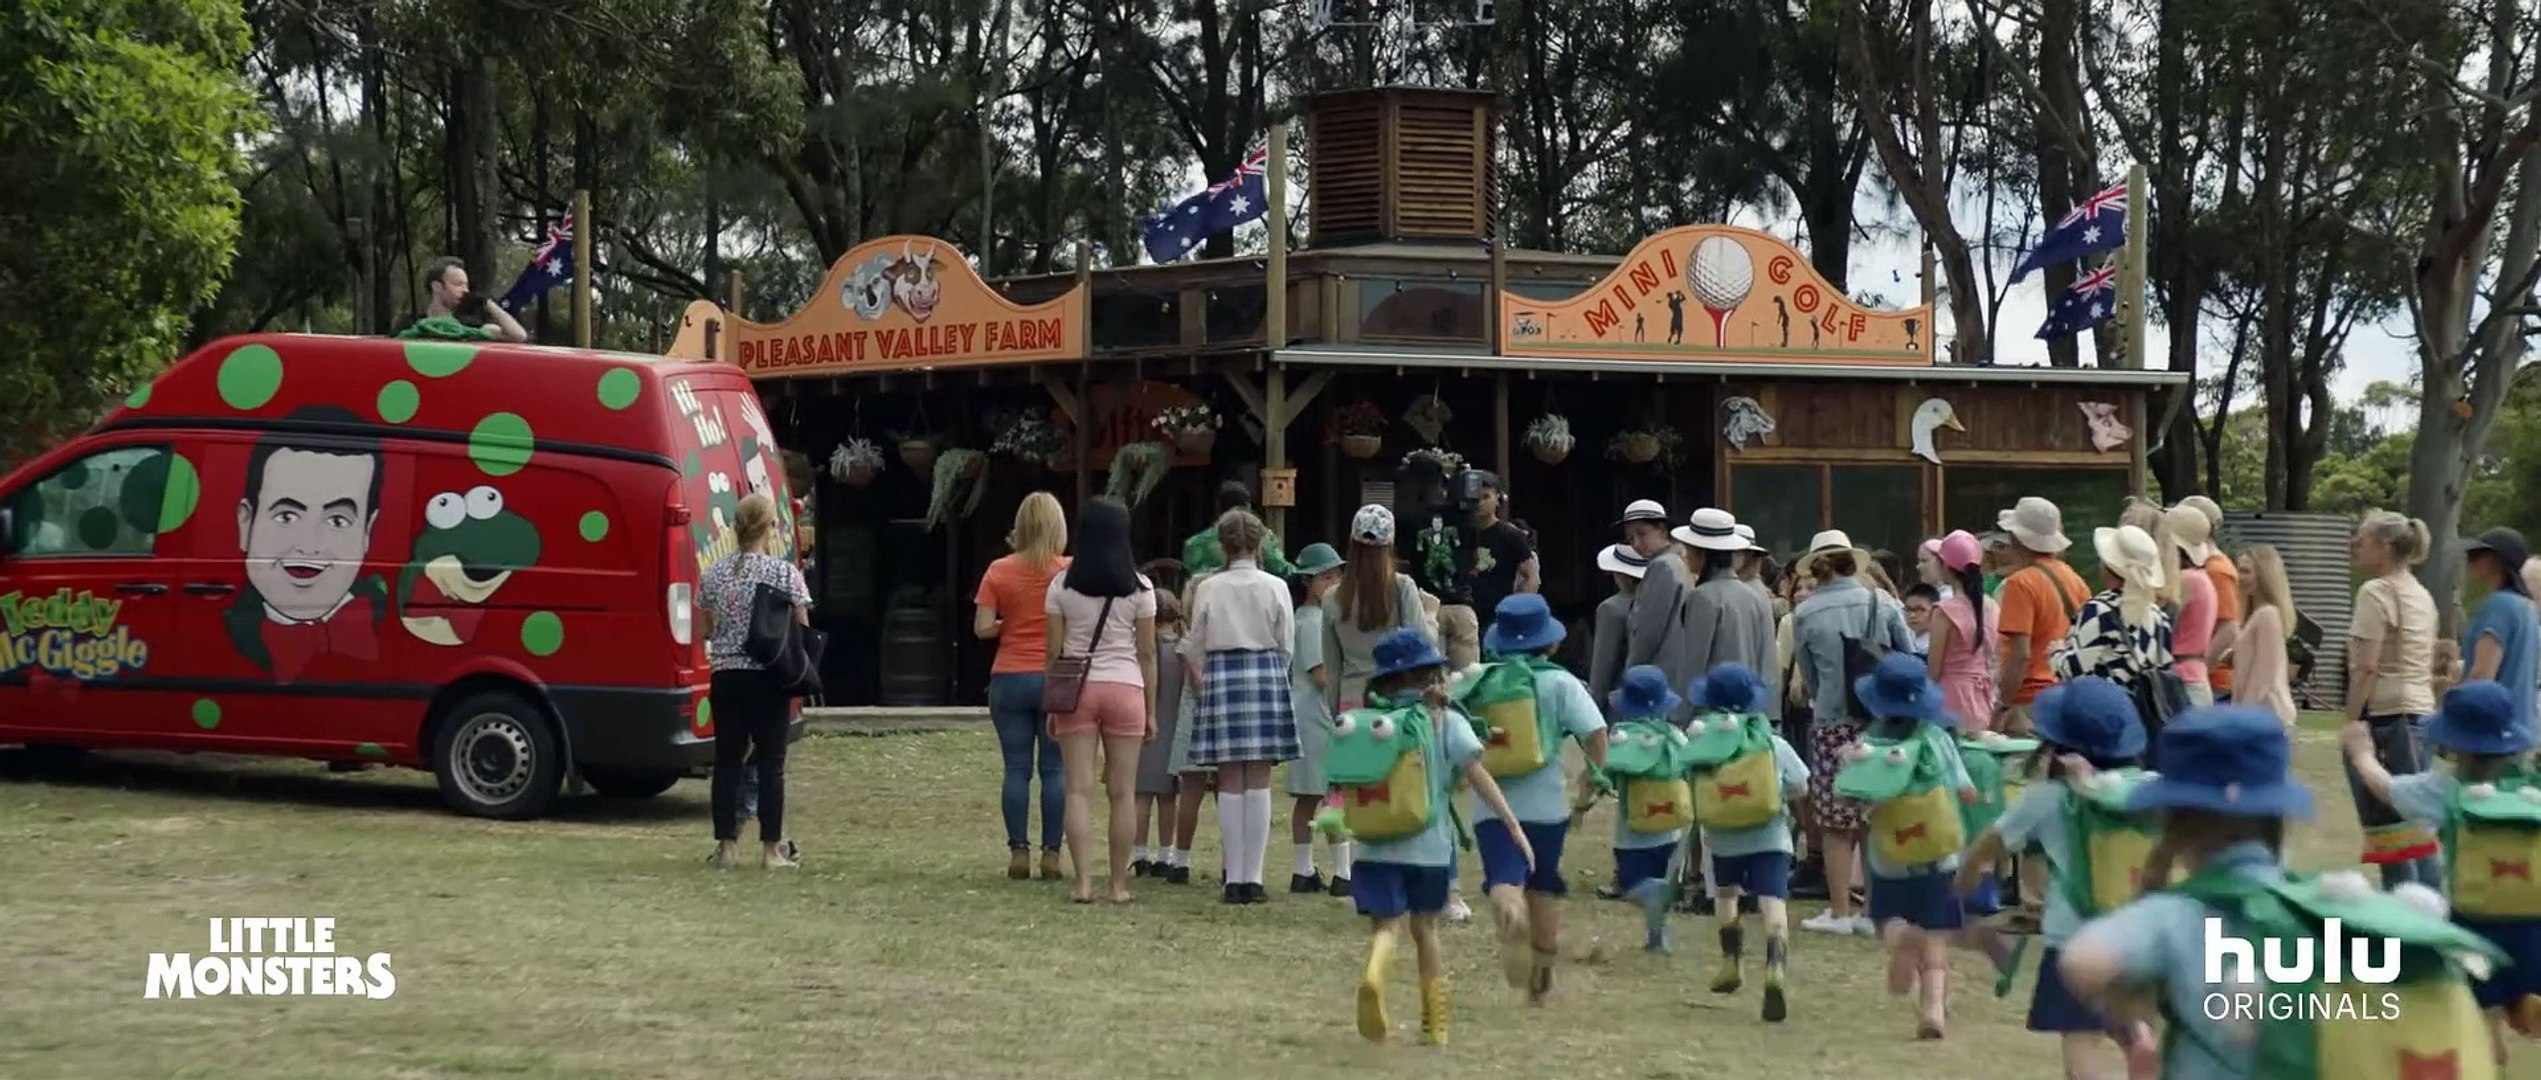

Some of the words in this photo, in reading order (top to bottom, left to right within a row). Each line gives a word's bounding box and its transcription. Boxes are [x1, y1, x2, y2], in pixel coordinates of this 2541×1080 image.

[1584, 249, 1678, 338] MINI
[1768, 255, 1866, 341] GOLF
[739, 331, 868, 369] PLEASANT
[874, 322, 977, 360] VALLEY
[985, 318, 1063, 352] FARM
[0, 587, 124, 637] Teddy
